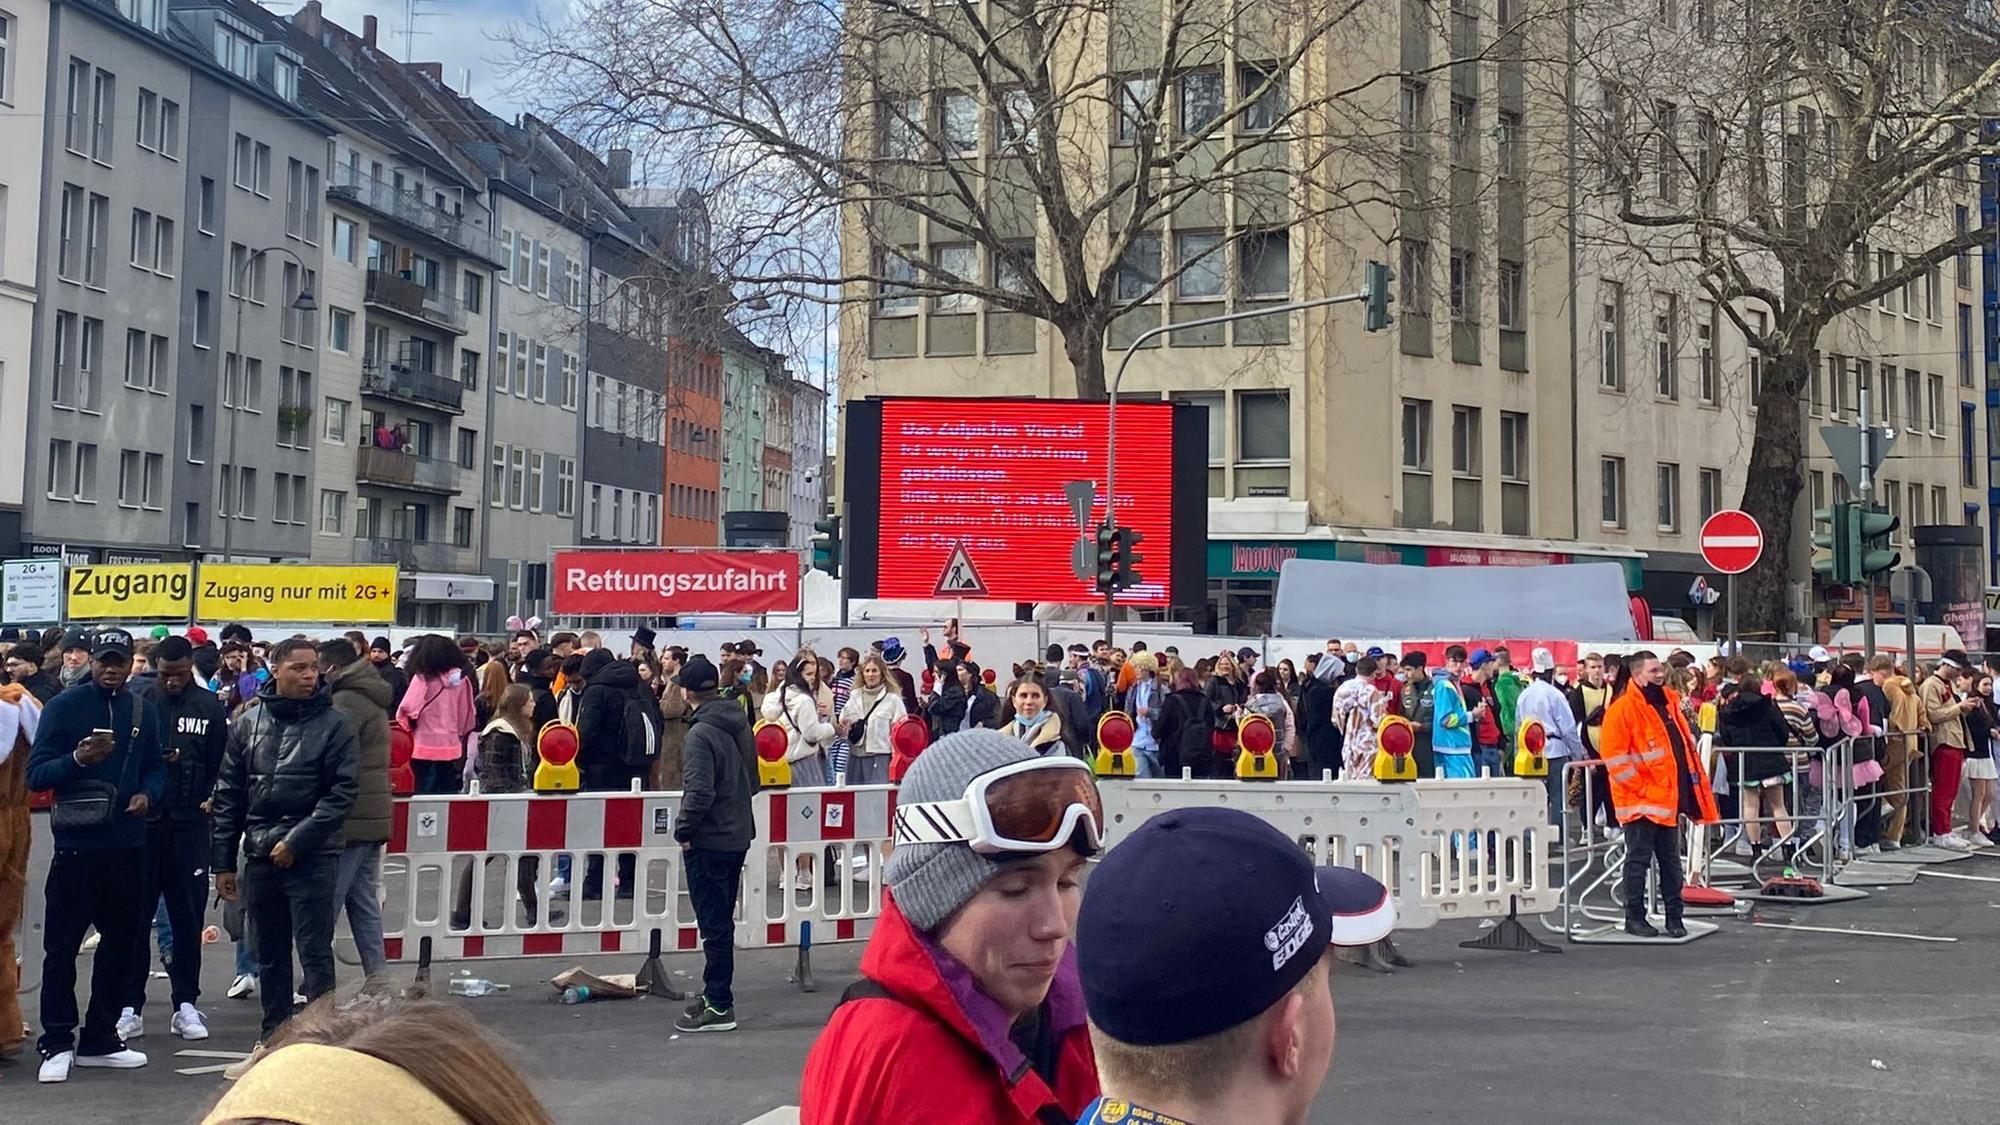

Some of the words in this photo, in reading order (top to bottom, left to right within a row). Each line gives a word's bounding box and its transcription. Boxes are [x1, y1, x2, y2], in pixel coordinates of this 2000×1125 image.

[33, 545, 60, 553] ROON
[22, 564, 37, 574] 2G
[72, 569, 188, 601] Zugang
[204, 582, 274, 602] Zugang
[281, 586, 312, 599] nur
[319, 584, 347, 599] mit
[354, 585, 377, 600] 2G
[380, 590, 390, 598] +
[566, 568, 787, 596] Rettungszufahrt
[177, 717, 209, 735] SWAT
[1272, 913, 1314, 971] EDGE
